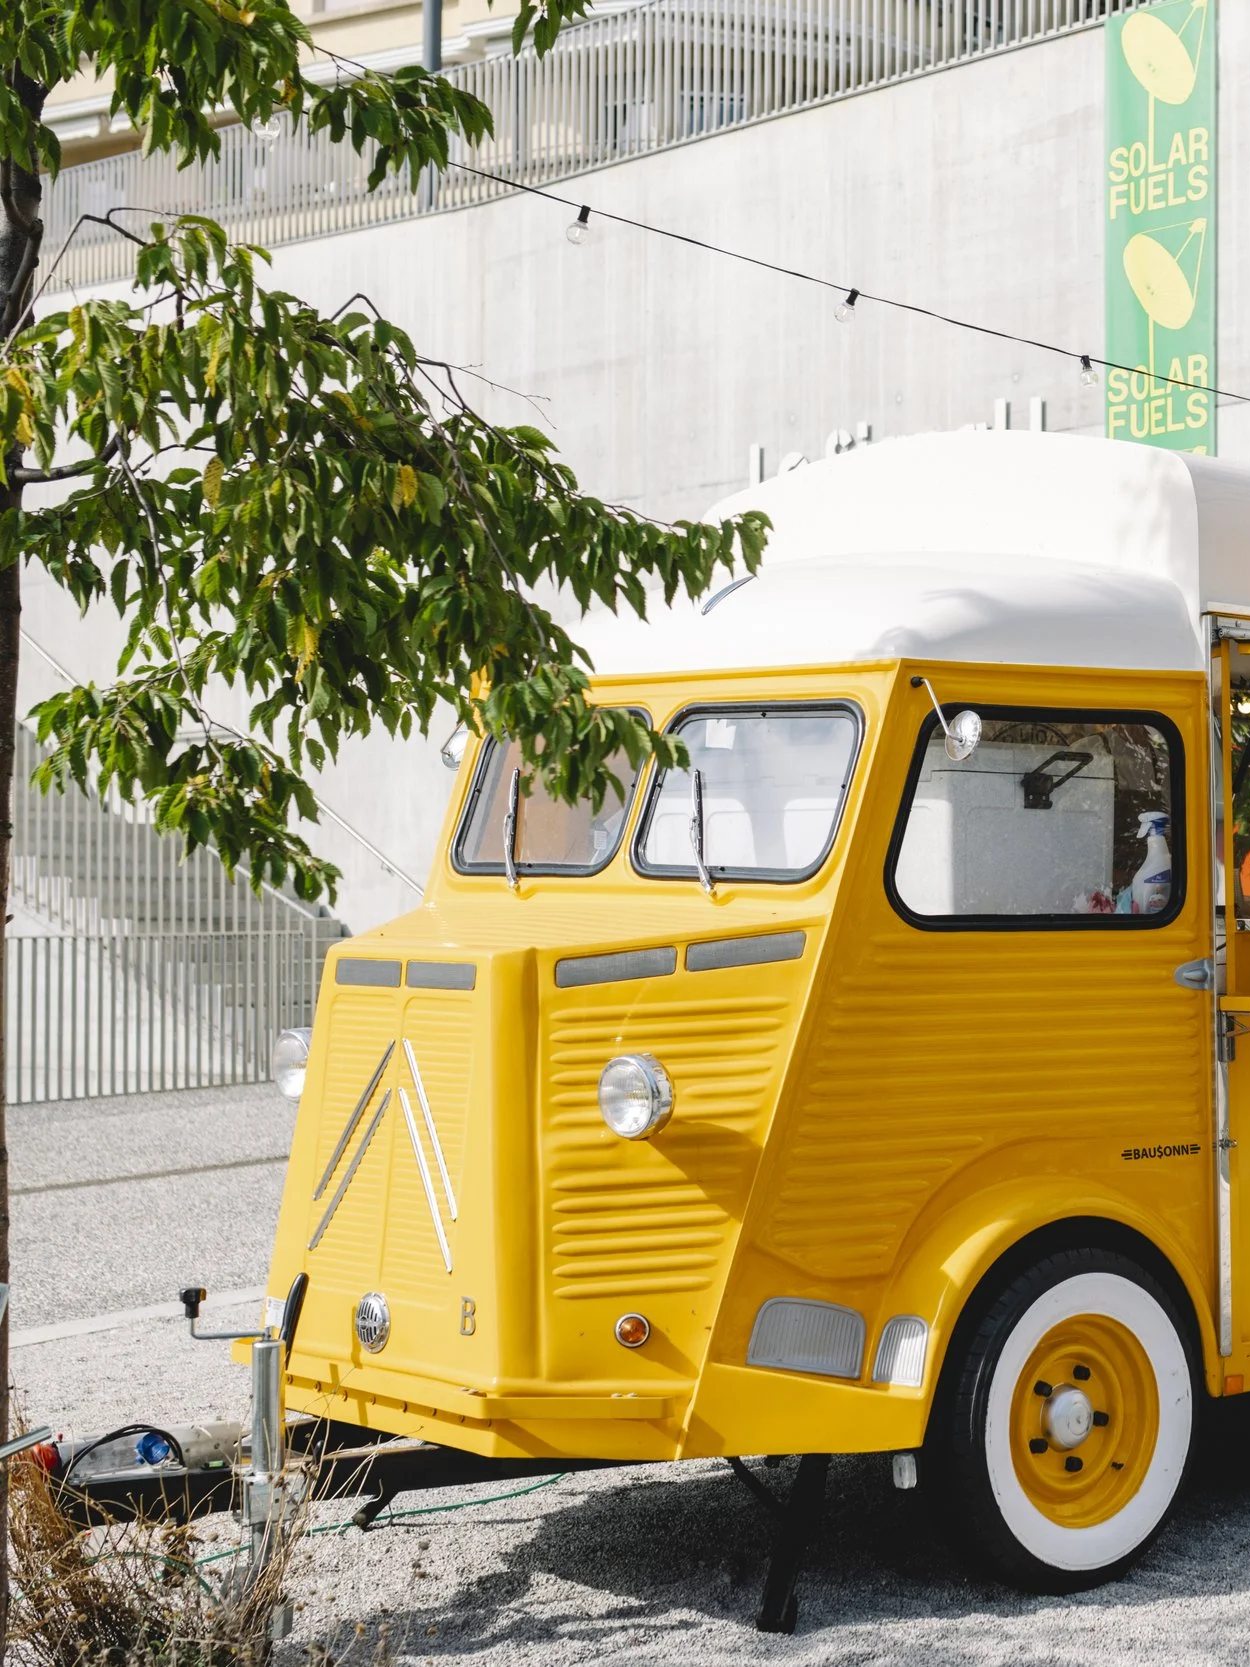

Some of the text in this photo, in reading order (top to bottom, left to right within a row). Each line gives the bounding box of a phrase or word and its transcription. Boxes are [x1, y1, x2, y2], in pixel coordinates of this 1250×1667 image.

[1108, 127, 1209, 182] SOLAR
[1109, 165, 1209, 220] FUELS
[1107, 354, 1208, 403] SOLAR
[1108, 392, 1208, 440] FUELS
[460, 1295, 476, 1336] B
